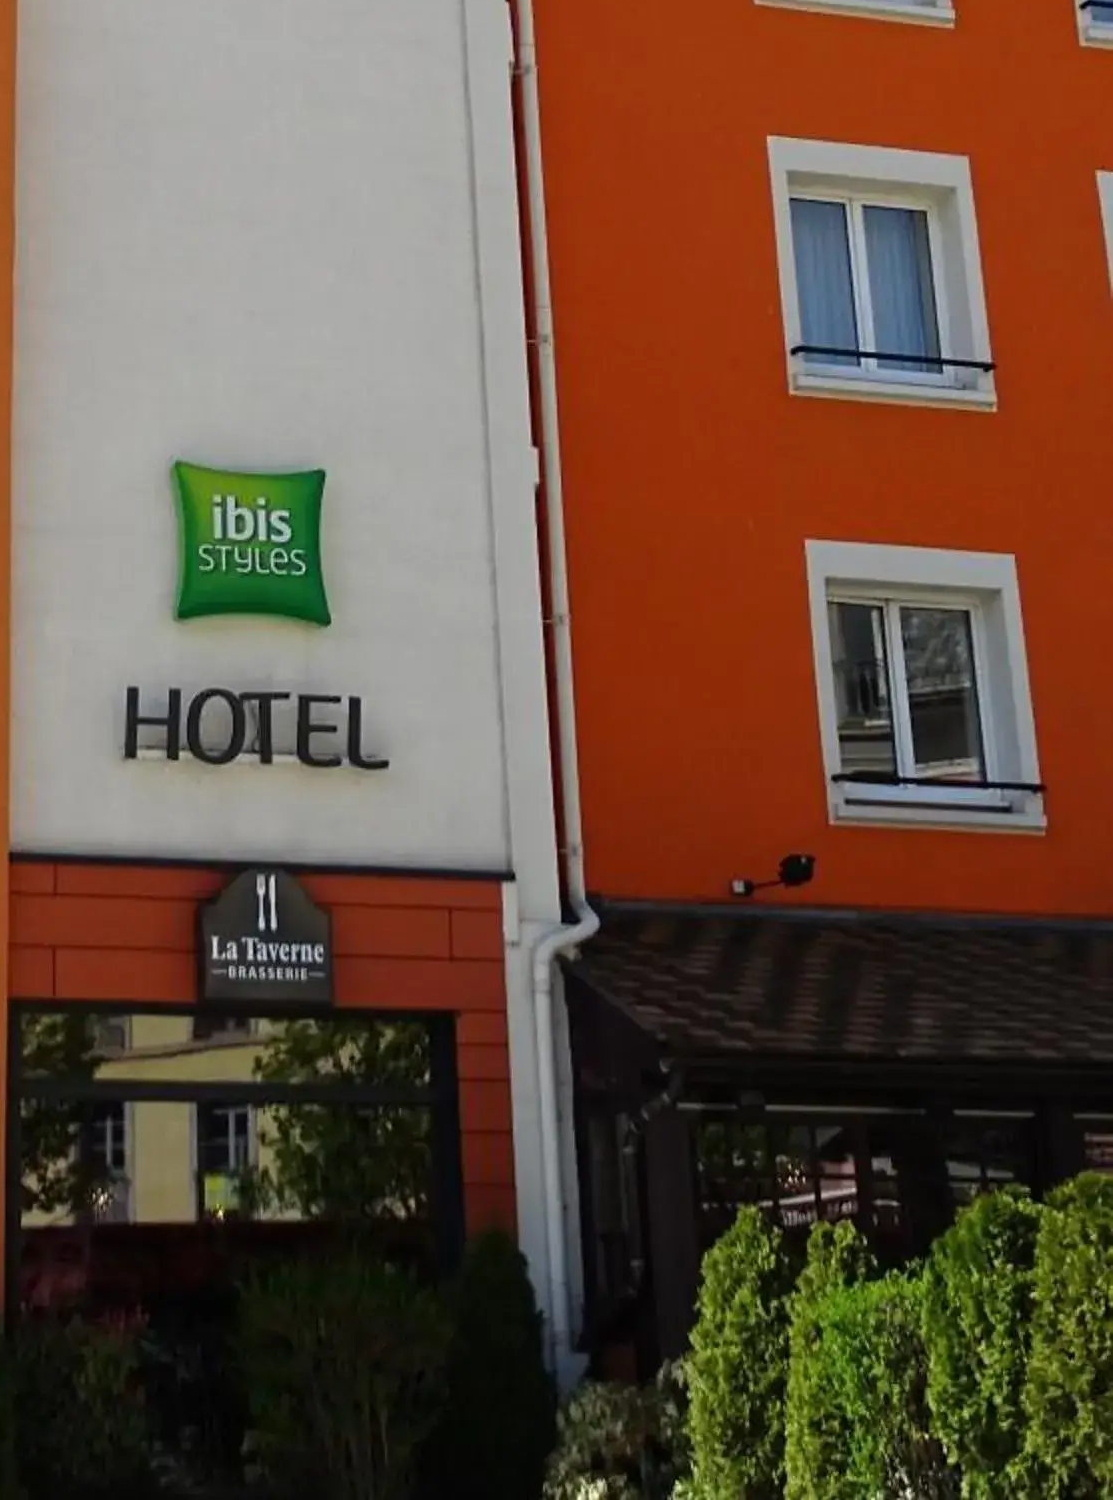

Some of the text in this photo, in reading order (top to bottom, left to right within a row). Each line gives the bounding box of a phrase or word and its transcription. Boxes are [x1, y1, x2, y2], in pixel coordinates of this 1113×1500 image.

[213, 494, 292, 543] ibis
[124, 686, 390, 770] HOTEL
[211, 935, 325, 964] La Taverne
[228, 965, 308, 981] BRASSERIE
